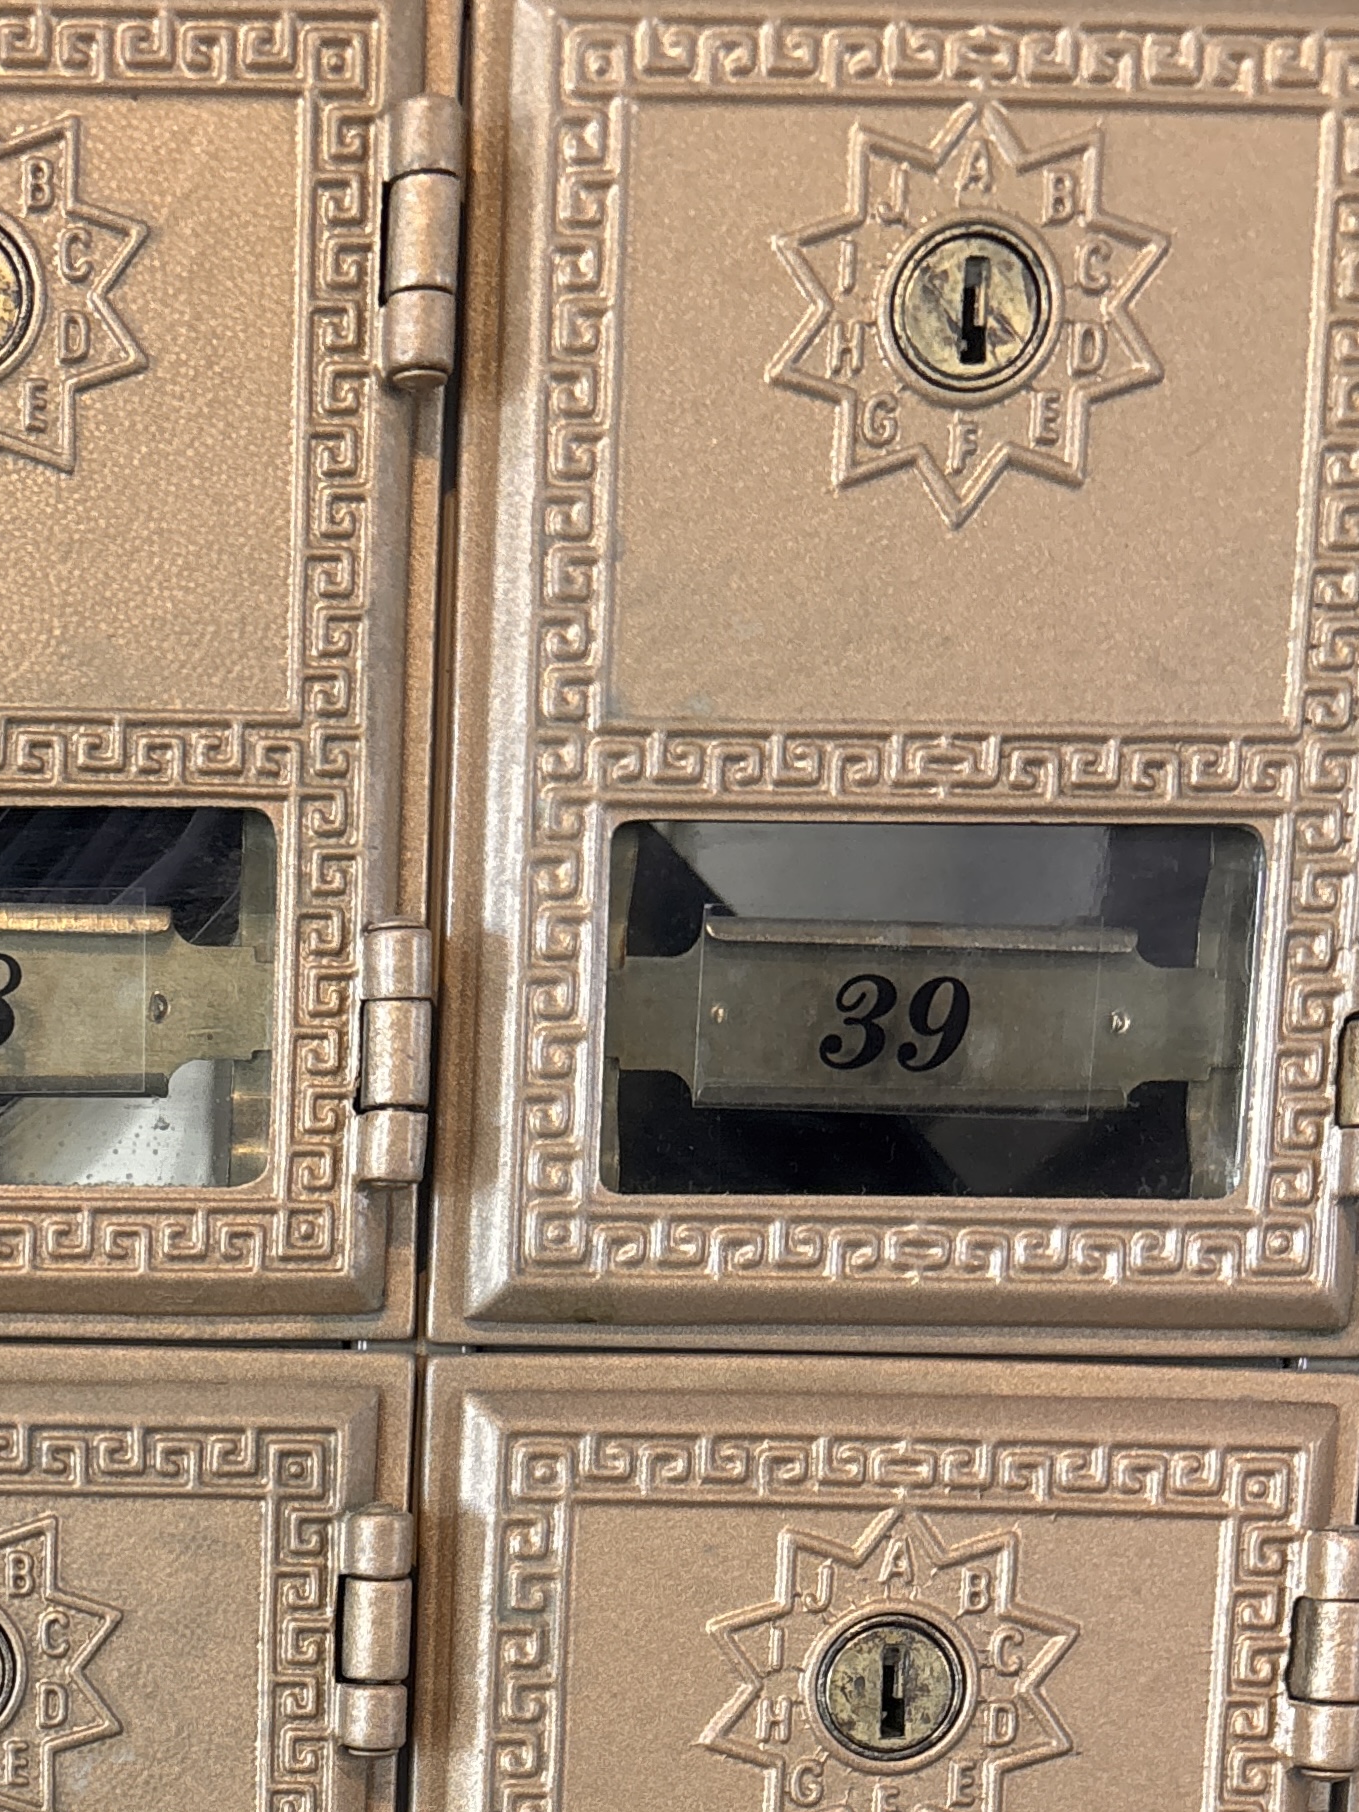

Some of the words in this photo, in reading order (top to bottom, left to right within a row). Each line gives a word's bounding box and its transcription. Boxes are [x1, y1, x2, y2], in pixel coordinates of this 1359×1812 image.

[23, 157, 54, 211] B
[956, 139, 992, 193] A
[877, 166, 906, 227] J
[1043, 171, 1076, 226] B
[58, 226, 93, 282] C
[840, 240, 856, 293] I
[1076, 240, 1112, 293] C
[58, 310, 91, 365] D
[828, 323, 864, 375] H
[1068, 321, 1107, 376] D
[23, 378, 48, 433] E
[862, 393, 897, 446] G
[1031, 392, 1060, 446] E
[949, 419, 978, 474] F
[818, 973, 971, 1072] 39
[5, 1551, 35, 1597] B
[878, 1538, 914, 1584] A
[803, 1562, 833, 1613] J
[959, 1567, 991, 1613] B
[40, 1610, 70, 1657] C
[769, 1627, 783, 1671] I
[991, 1626, 1024, 1675] C
[37, 1681, 68, 1728] D
[756, 1699, 791, 1743] H
[985, 1700, 1018, 1746] D
[4, 1740, 29, 1786] E
[790, 1759, 824, 1806] G
[948, 1760, 974, 1806] E
